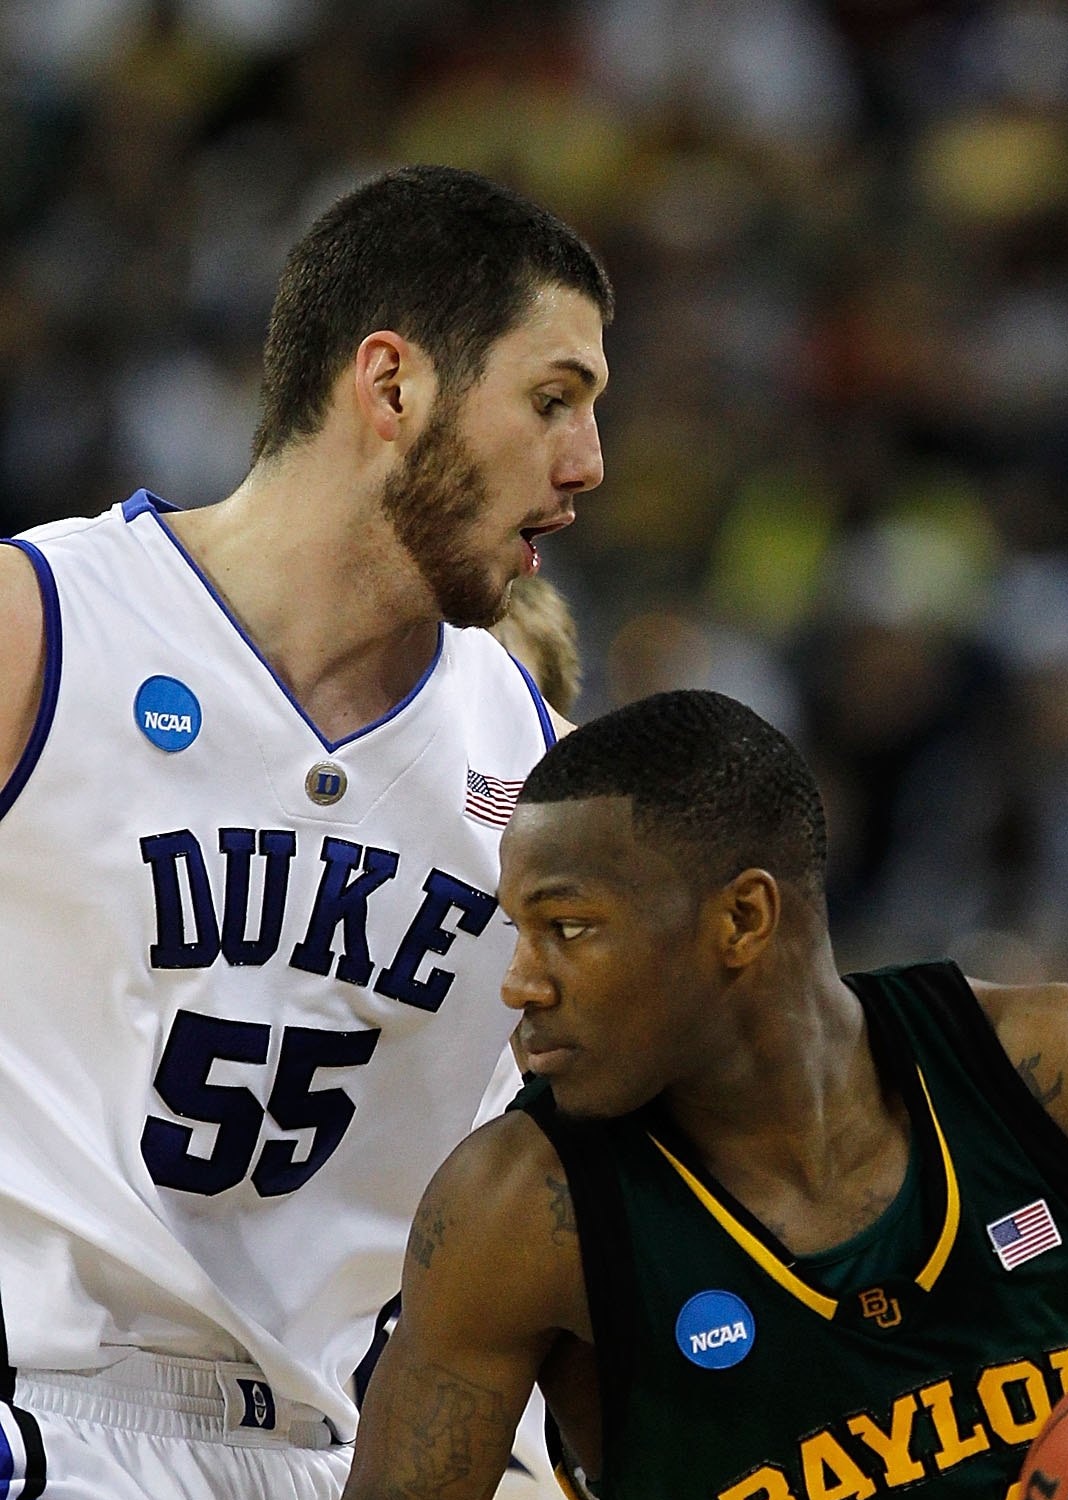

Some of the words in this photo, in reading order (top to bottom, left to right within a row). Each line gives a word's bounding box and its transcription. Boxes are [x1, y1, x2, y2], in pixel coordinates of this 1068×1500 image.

[144, 711, 192, 733] NCAA
[139, 828, 499, 1013] DUKE
[140, 1009, 382, 1198] 55
[689, 1321, 747, 1354] NCAA
